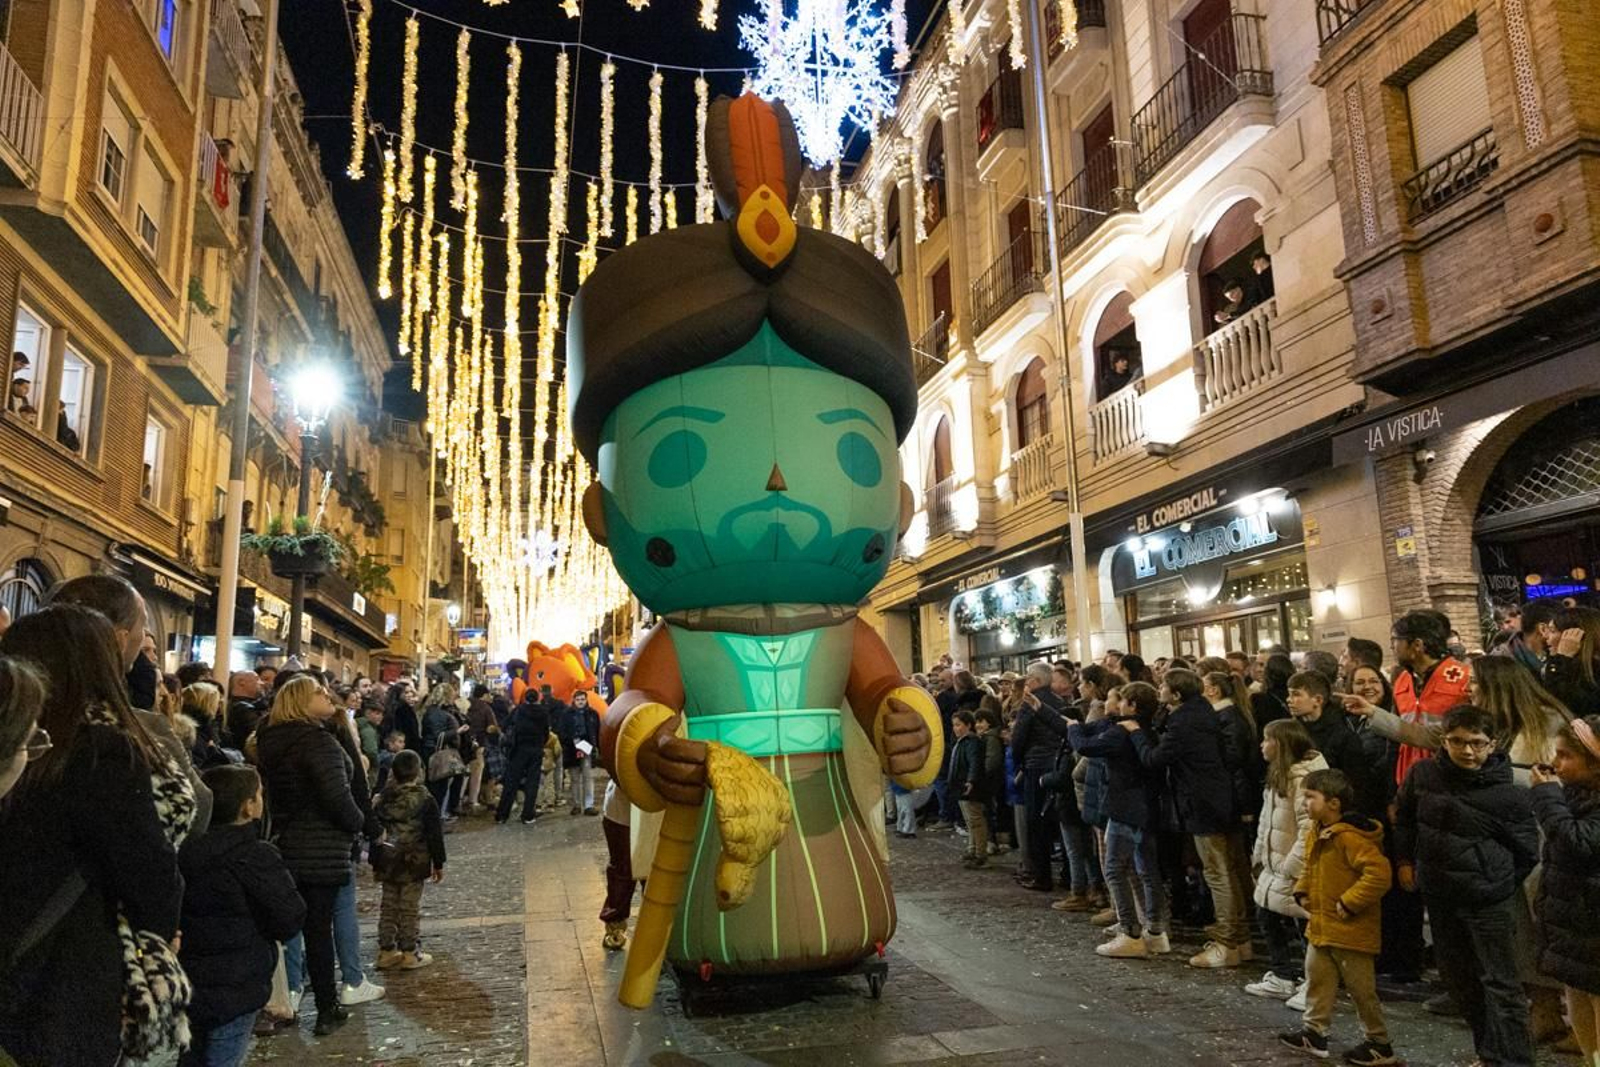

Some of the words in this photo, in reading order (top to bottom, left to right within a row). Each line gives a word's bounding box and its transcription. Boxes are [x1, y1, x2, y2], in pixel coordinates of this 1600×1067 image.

[1368, 426, 1385, 452] LA
[1387, 406, 1441, 442] VISTICA
[1136, 515, 1151, 534] EL
[1152, 487, 1218, 528] COMERCIAL
[1132, 548, 1157, 579] EL
[1162, 511, 1278, 572] COMERCIAL
